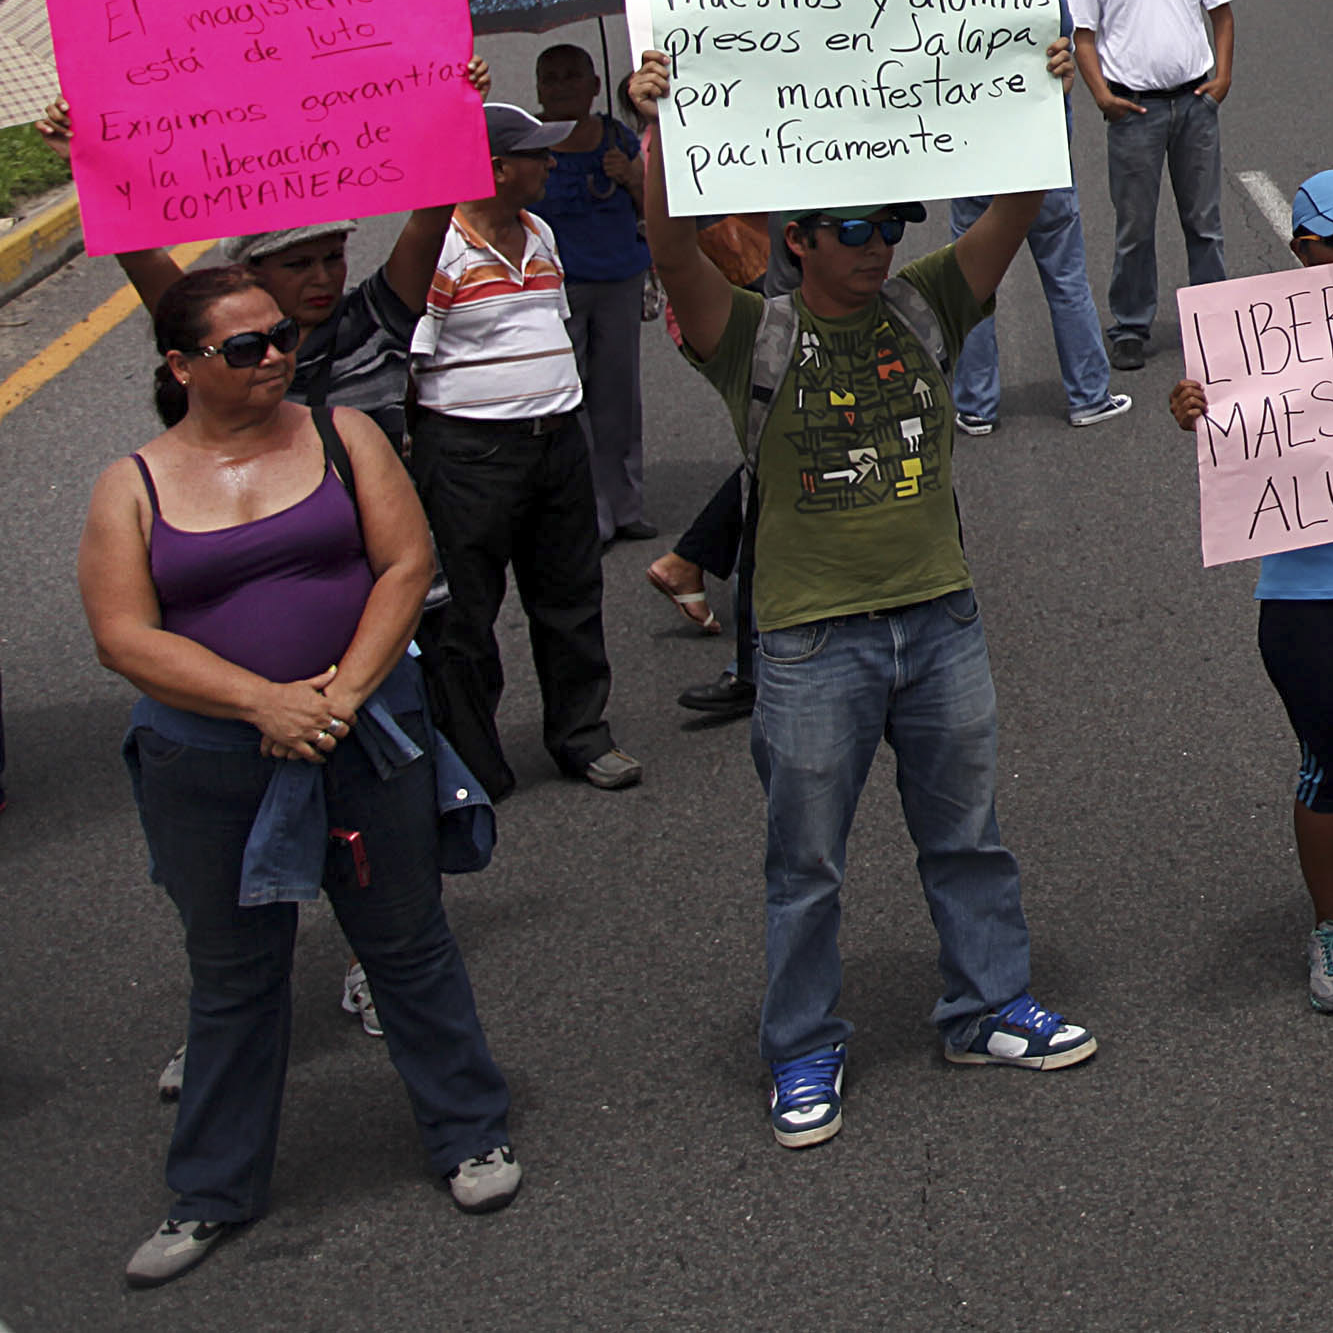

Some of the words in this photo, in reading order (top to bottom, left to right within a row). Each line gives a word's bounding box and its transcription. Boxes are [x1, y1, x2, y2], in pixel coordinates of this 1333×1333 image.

[126, 46, 205, 87] está
[244, 41, 282, 66] de
[306, 22, 377, 52] luto
[663, 25, 802, 79] presos
[825, 28, 873, 53] en
[890, 13, 1038, 59] Jalapa
[99, 101, 267, 155] Exigimos
[301, 60, 469, 123] garantías
[674, 77, 742, 127] por
[777, 56, 1027, 111] manifestarse
[116, 180, 132, 212] y
[149, 158, 178, 190] la
[201, 132, 341, 181] liberación
[356, 122, 392, 151] de
[162, 158, 405, 223] COMPAÑEROS
